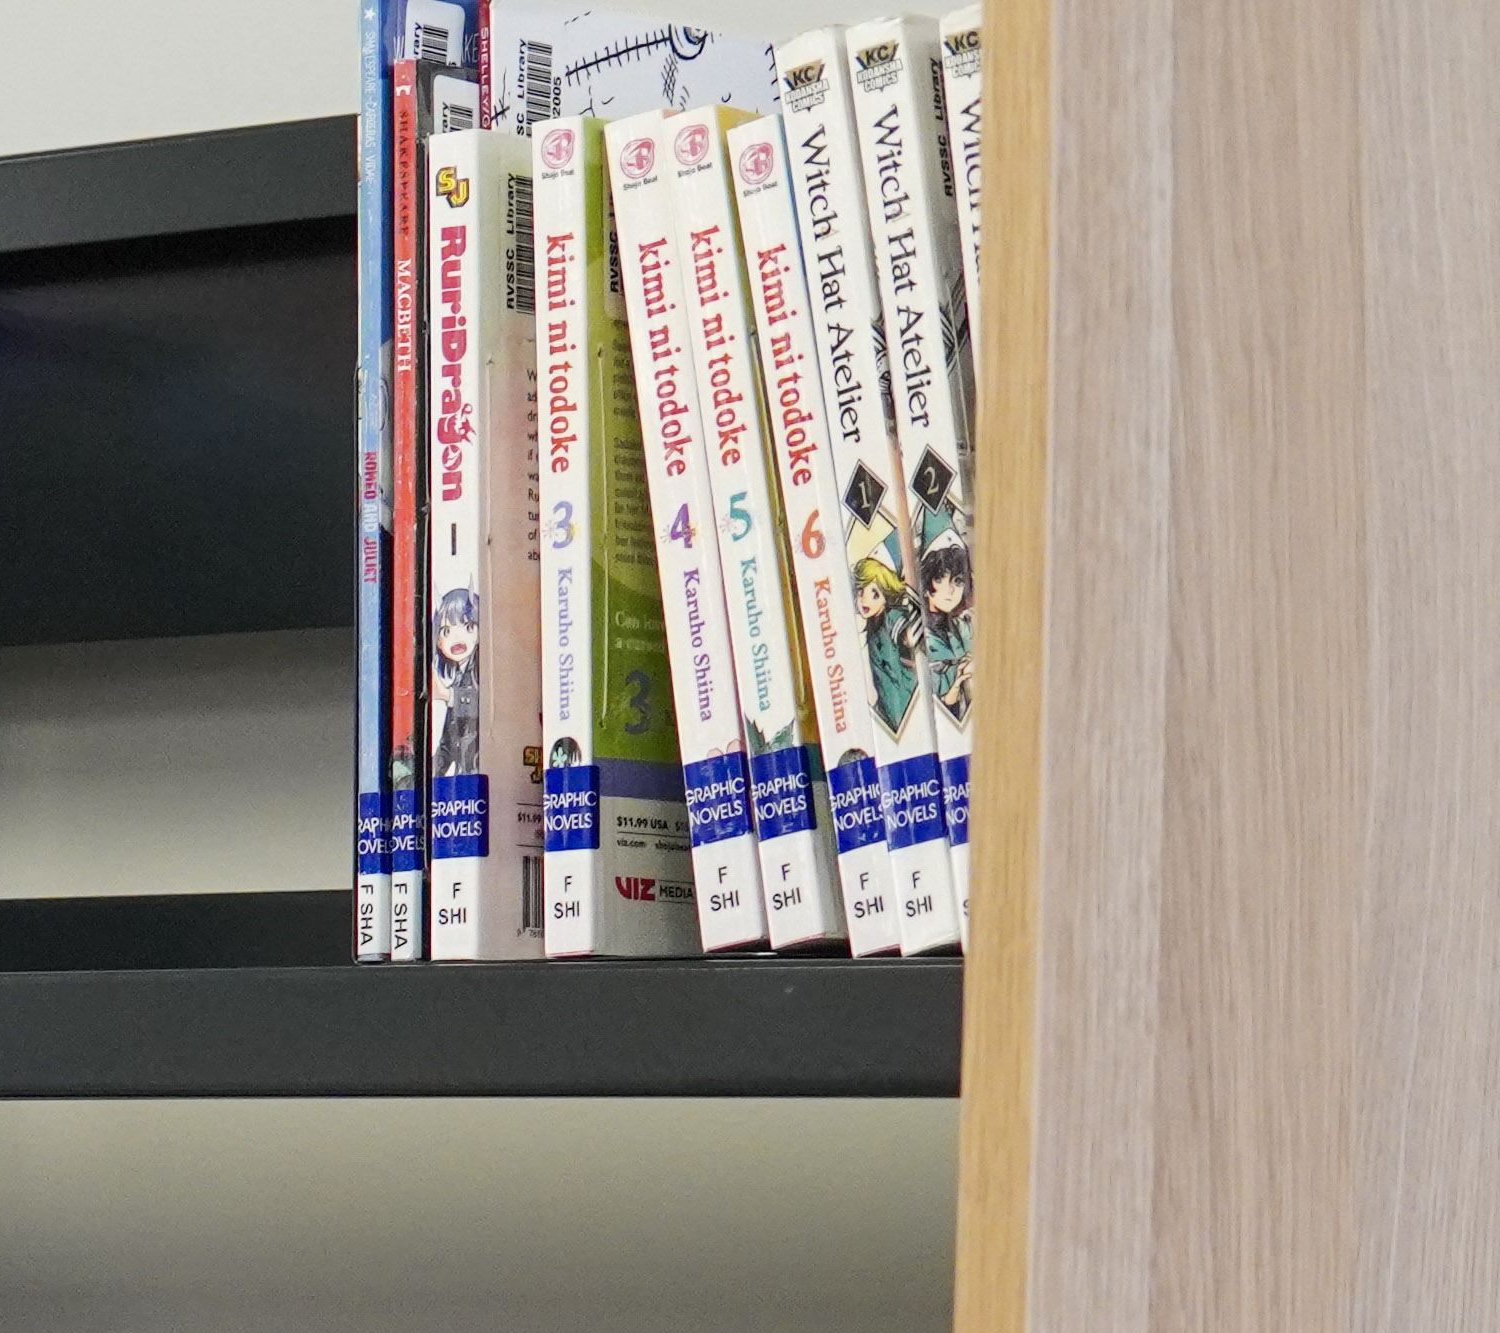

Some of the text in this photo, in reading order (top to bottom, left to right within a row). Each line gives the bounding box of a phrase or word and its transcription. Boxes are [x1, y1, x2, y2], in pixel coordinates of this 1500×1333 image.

[506, 174, 517, 309] RVSSC Library
[874, 104, 930, 428] Witch Hat Atelier
[397, 259, 412, 372] MACBETH
[802, 124, 860, 444] Witch Hat Atelier
[547, 231, 576, 474] kimi ni todoke
[758, 243, 818, 486] kimi ni todoke
[552, 501, 575, 549] 3
[801, 509, 824, 558] 6
[558, 567, 574, 721] Karuho Shiina
[431, 799, 487, 818] GRAPHIC
[432, 820, 483, 838] NOVELS
[616, 816, 668, 830] $11.99 USA
[438, 908, 467, 924] SHI
[615, 875, 656, 901] VIZ
